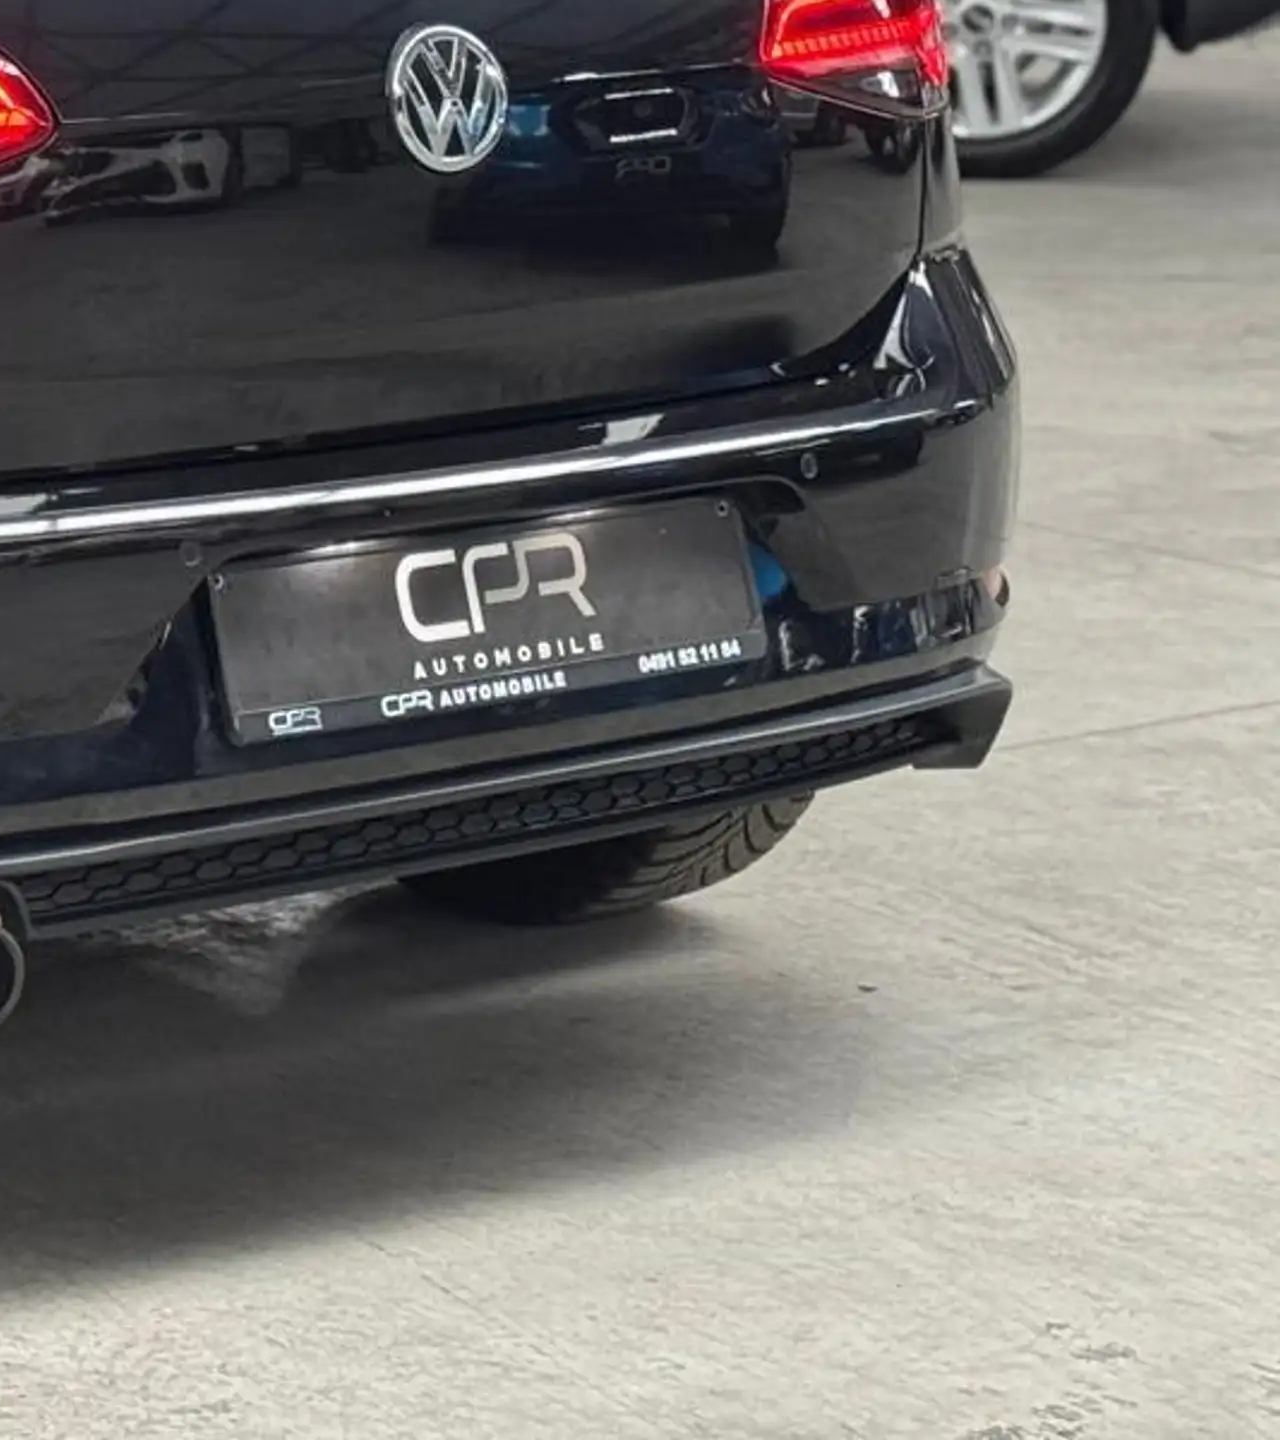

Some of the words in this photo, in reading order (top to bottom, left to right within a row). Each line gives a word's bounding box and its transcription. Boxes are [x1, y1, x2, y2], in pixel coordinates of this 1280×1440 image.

[388, 24, 508, 172] VW
[395, 533, 596, 643] CPR
[413, 632, 605, 680] AUTOMOBILE
[381, 689, 434, 718] CPR
[440, 670, 567, 708] AUTOMOBILE
[268, 706, 323, 734] CPR
